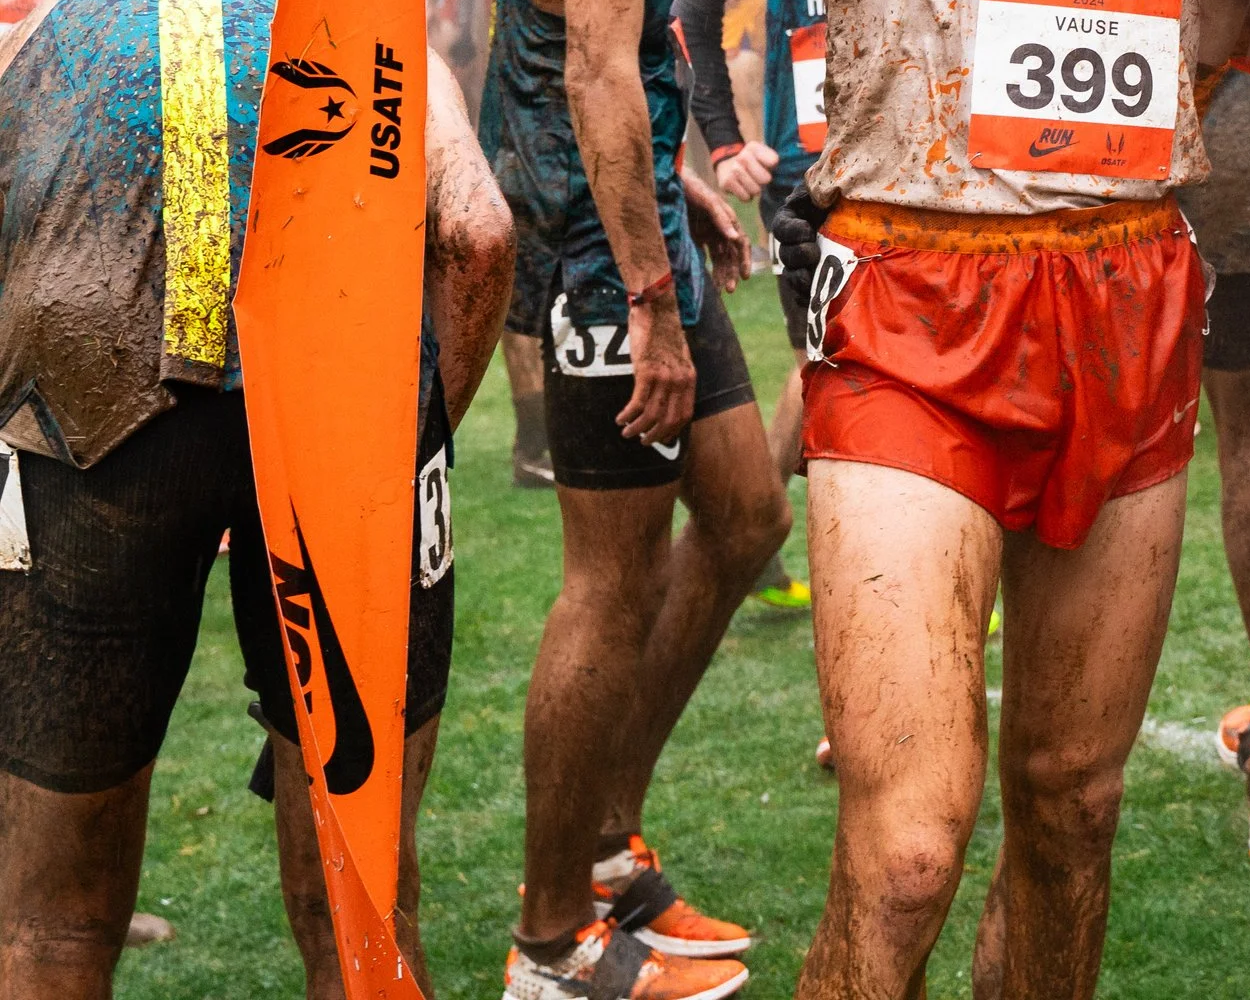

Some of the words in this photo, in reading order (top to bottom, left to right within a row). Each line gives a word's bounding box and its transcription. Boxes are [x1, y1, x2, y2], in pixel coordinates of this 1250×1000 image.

[1055, 15, 1119, 36] VAUSE
[370, 42, 403, 179] USATF
[1006, 42, 1154, 118] 399
[1038, 127, 1075, 146] RUN
[426, 467, 449, 571] 3
